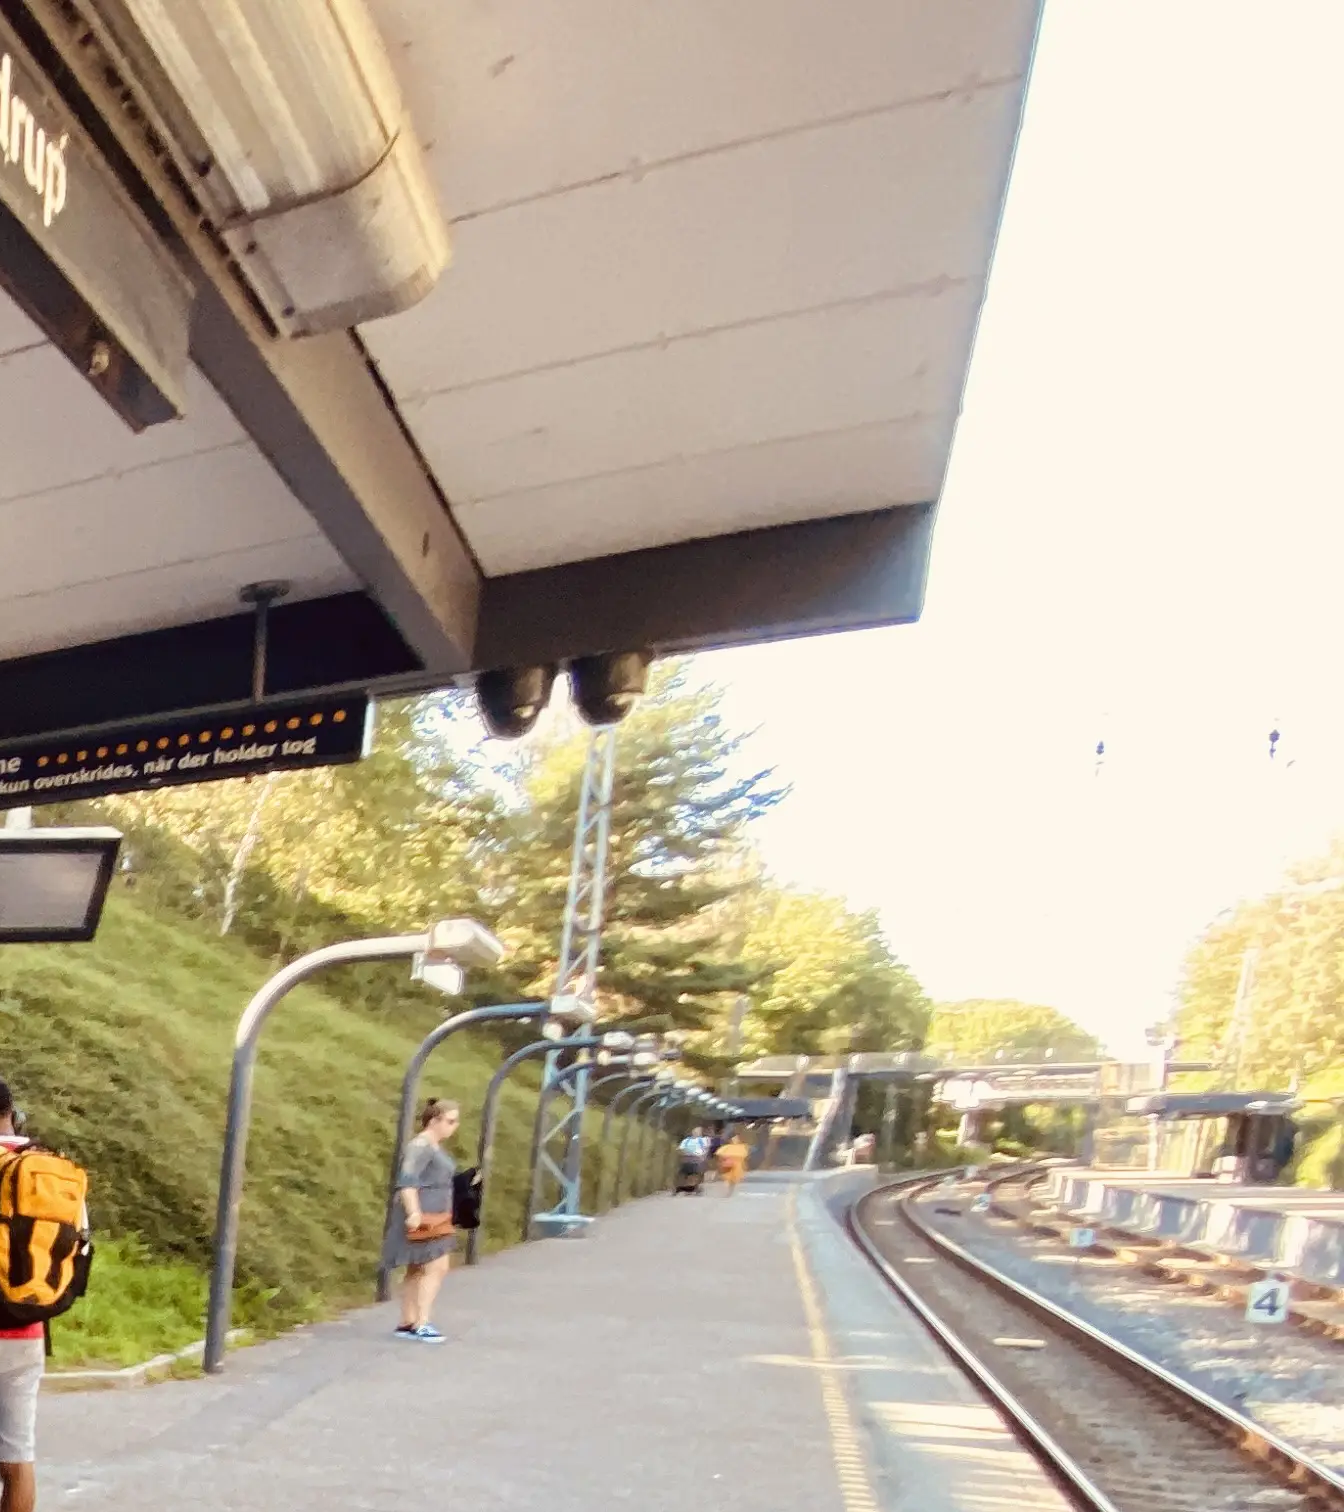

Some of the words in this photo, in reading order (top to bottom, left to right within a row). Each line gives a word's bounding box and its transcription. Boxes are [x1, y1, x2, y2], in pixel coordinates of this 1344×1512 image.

[0, 780, 30, 795] kun
[143, 755, 175, 775] når
[178, 751, 211, 770] der
[213, 741, 278, 765] holder
[281, 736, 317, 757] tog
[1253, 1287, 1282, 1317] 4
